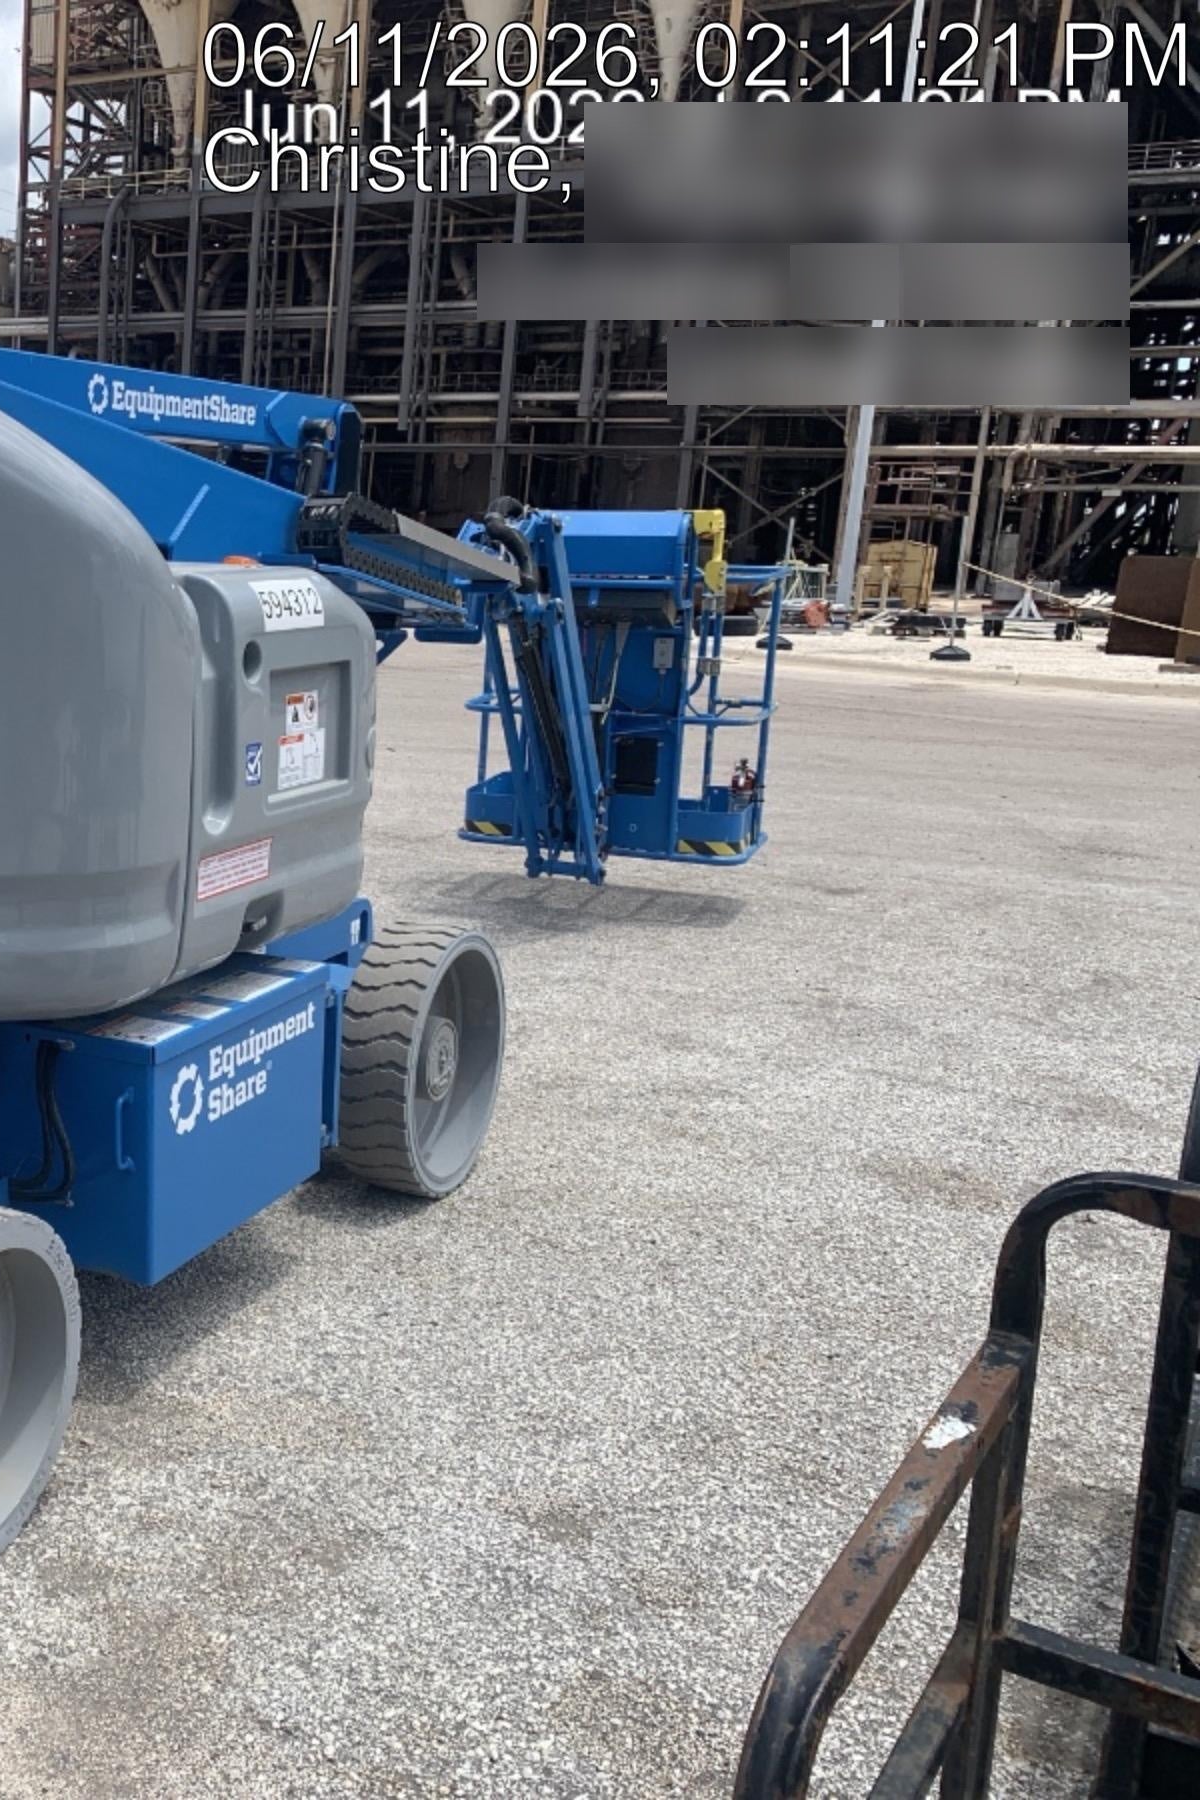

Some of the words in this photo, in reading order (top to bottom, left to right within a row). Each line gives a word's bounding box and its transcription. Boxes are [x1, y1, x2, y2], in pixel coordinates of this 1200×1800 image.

[111, 380, 257, 426] EquipmentShare
[257, 586, 323, 619] 594312
[208, 1001, 316, 1081] Equipment
[207, 1069, 268, 1123] Share
